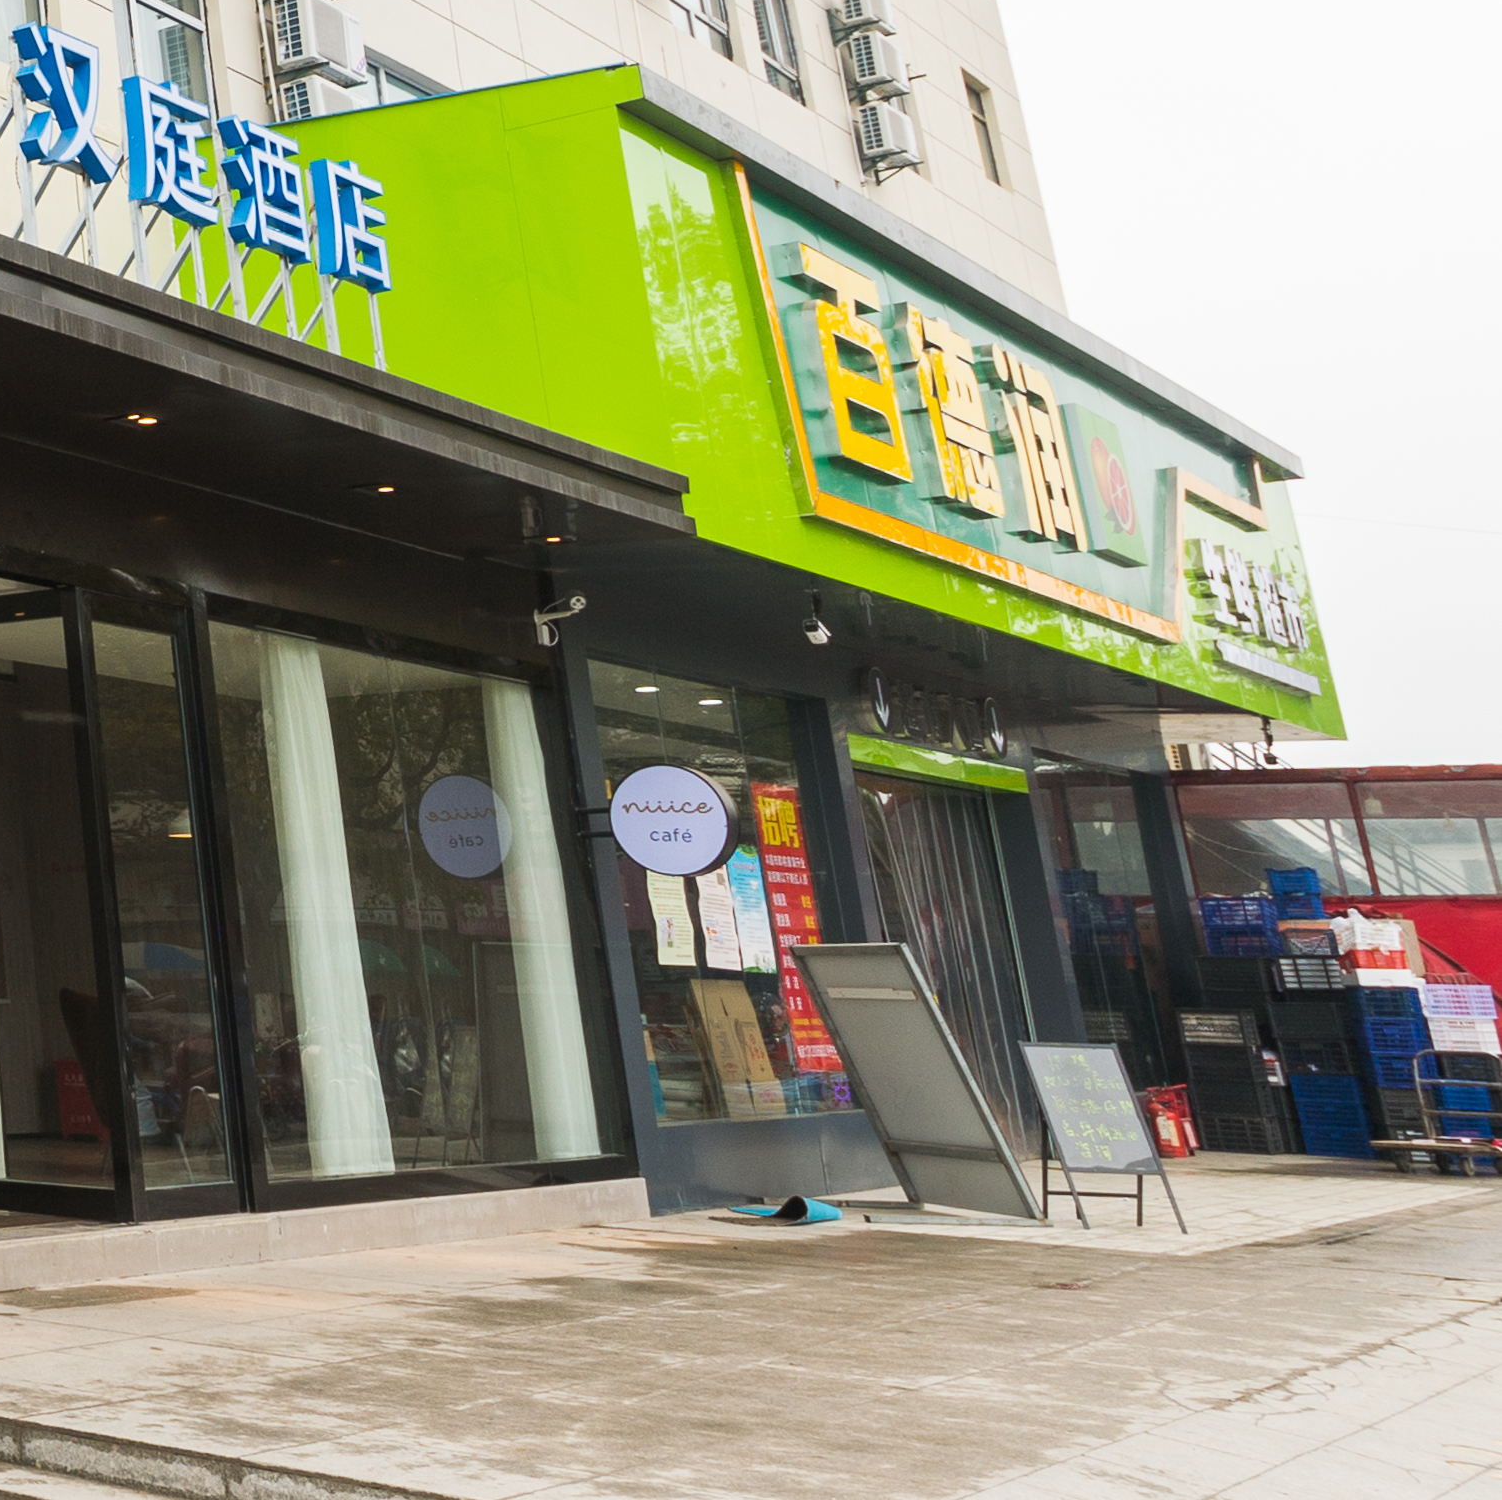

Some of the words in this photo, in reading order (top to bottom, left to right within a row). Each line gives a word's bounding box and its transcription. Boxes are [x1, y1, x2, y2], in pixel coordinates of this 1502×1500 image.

[12, 21, 392, 293] 汉庭酒店
[622, 800, 714, 814] niiice
[757, 795, 800, 849] 招聘
[649, 828, 693, 843] café
